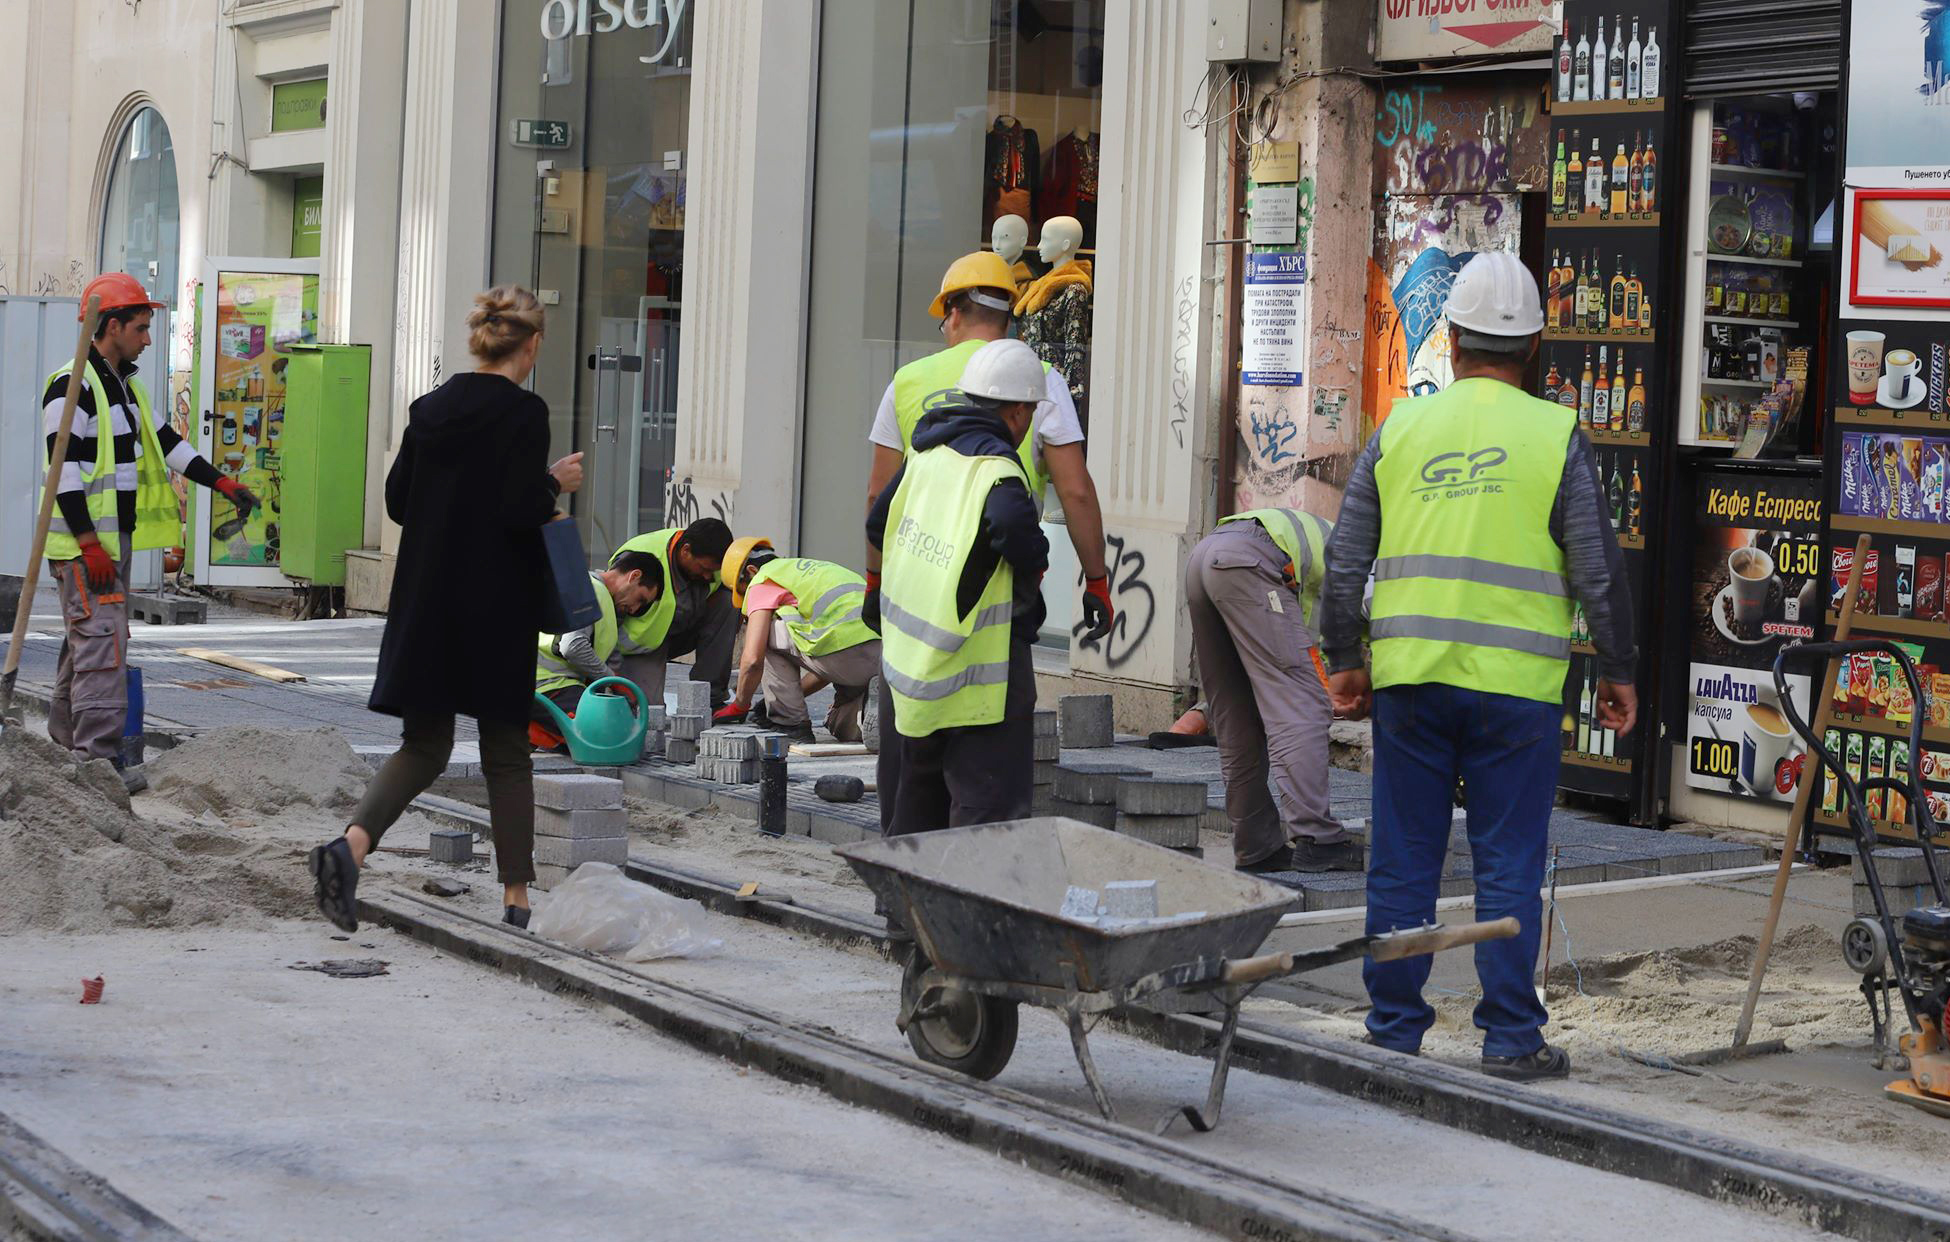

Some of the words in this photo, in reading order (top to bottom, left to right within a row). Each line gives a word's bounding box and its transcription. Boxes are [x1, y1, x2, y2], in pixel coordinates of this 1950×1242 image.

[1905, 169, 1941, 180] Пушенето
[1279, 256, 1304, 271] ХЪРС
[1270, 319, 1296, 327] ИНЦИДЕНТИ
[1930, 345, 1944, 413] SNICKERS
[1446, 486, 1480, 500] GROUP
[1844, 458, 1857, 499] Milka
[1884, 463, 1899, 519] Caramel
[1707, 488, 1750, 521] Кафе
[1861, 483, 1870, 514] Milka
[1880, 486, 1888, 510] Milka
[1900, 481, 1912, 518] Milka
[897, 537, 950, 570] ostruct
[908, 522, 955, 561] Group
[1778, 542, 1819, 575] 0.50
[1762, 623, 1814, 638] SPETEM
[1695, 673, 1758, 704] LAVAZZA
[1695, 702, 1732, 722] капсула
[1693, 741, 1732, 775] 1.00
